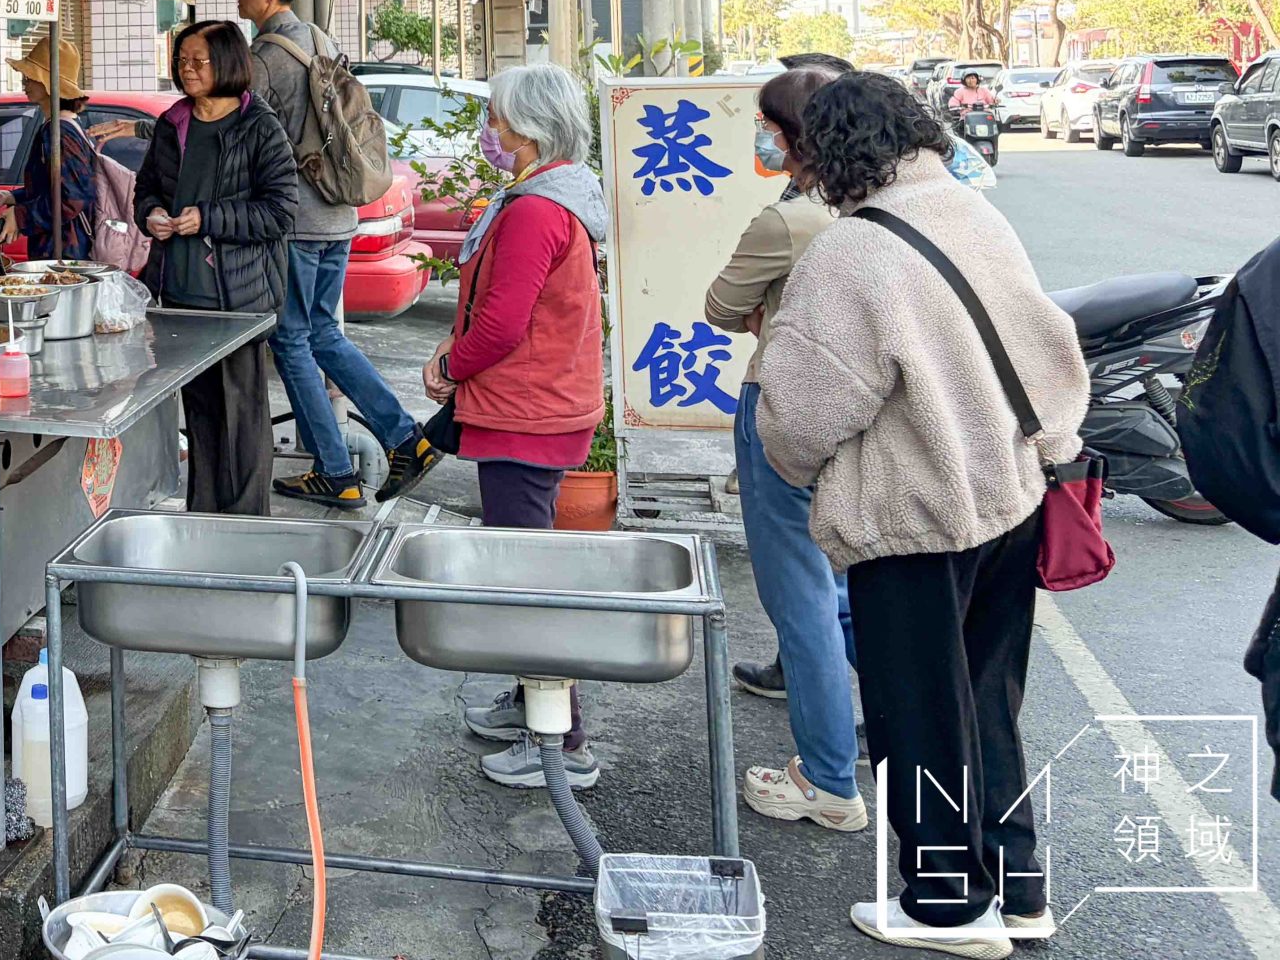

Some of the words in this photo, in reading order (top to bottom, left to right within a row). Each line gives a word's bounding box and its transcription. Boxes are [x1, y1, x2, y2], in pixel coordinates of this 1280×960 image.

[5, 0, 19, 14] 50
[26, 1, 41, 16] 100
[632, 99, 738, 415] 蒸餃
